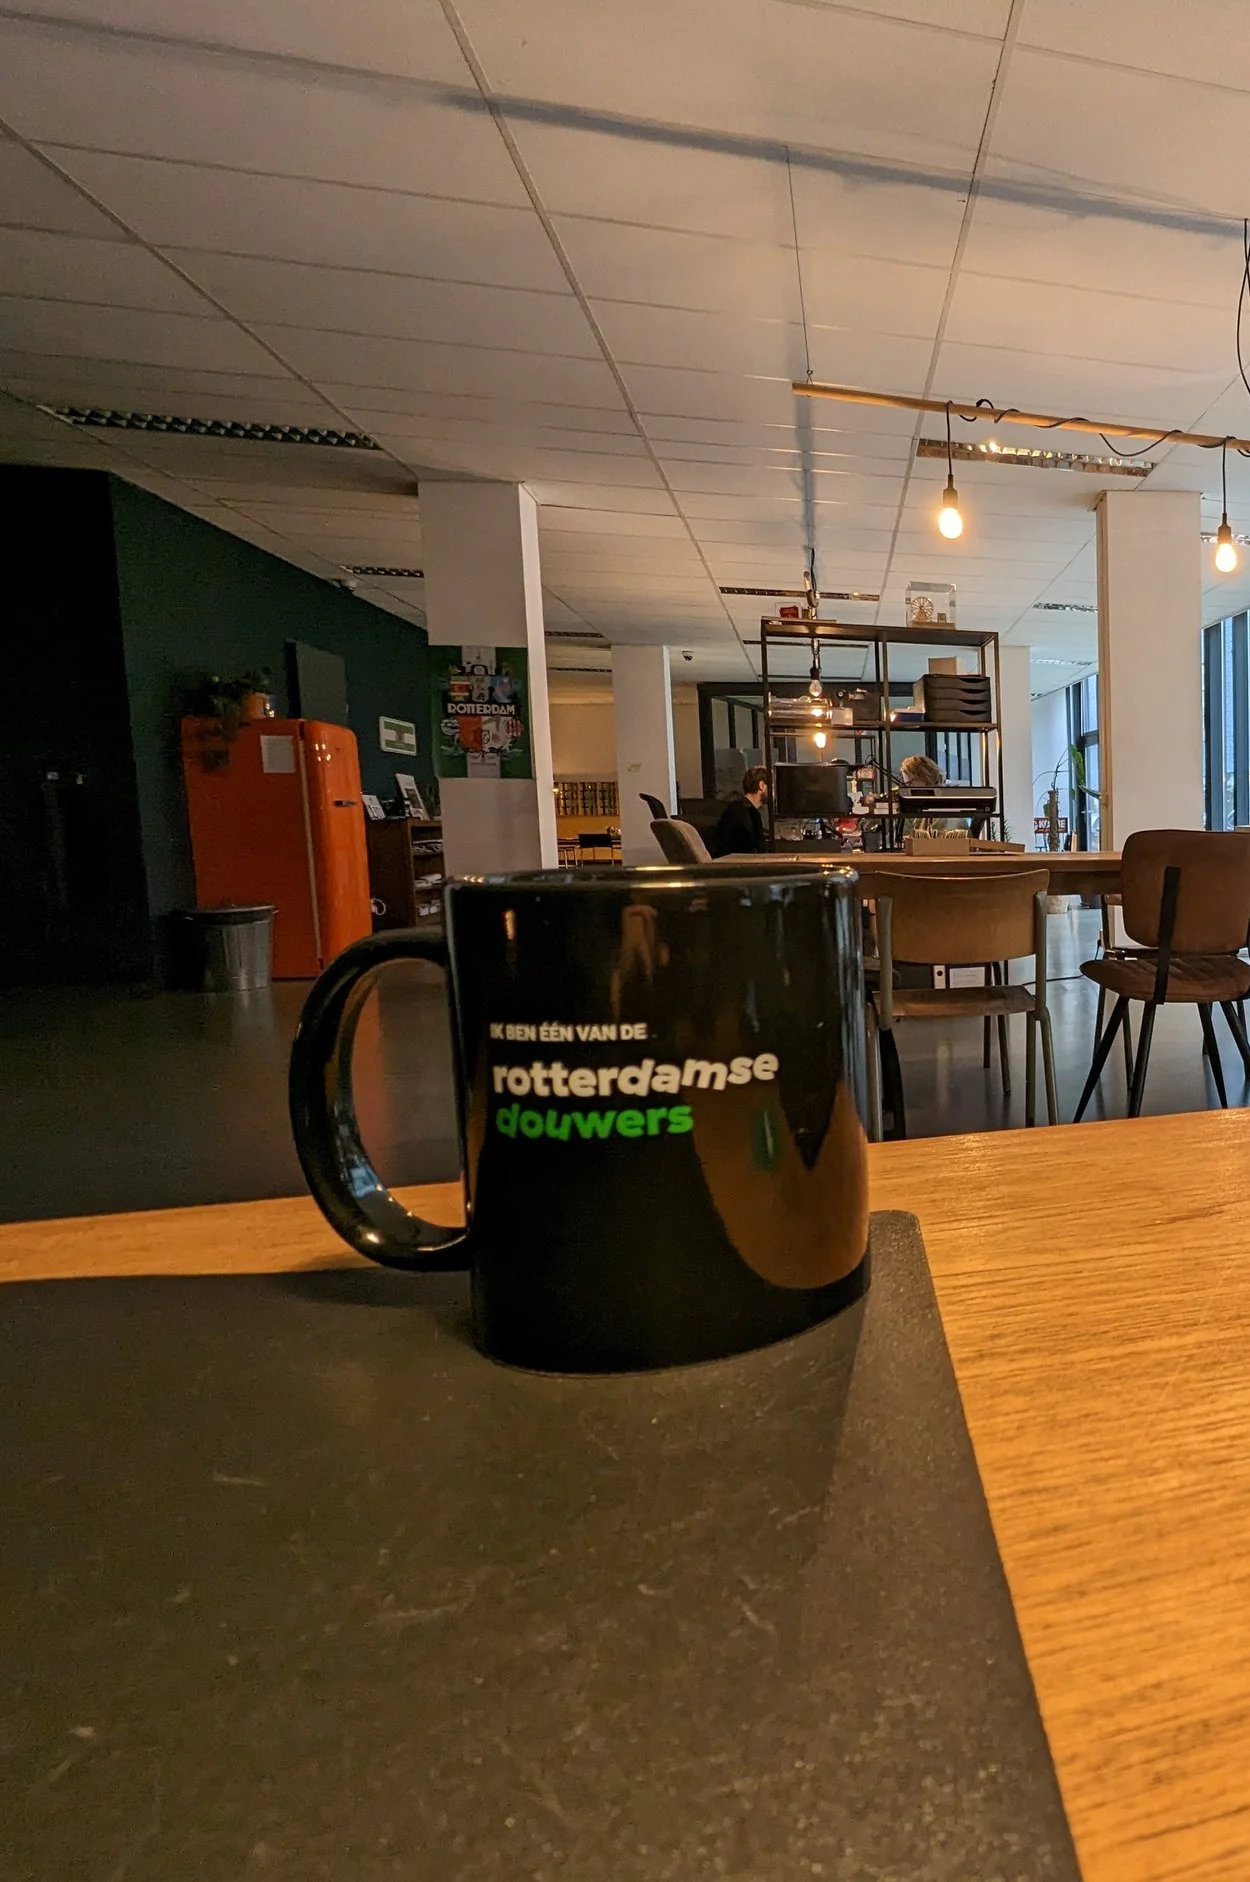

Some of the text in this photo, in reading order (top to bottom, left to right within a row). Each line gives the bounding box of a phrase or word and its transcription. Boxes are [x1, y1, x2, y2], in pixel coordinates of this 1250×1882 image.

[447, 703, 516, 715] ROTTERDAM
[490, 1020, 648, 1042] IK BEN ÉÉN VAN DE
[493, 1053, 779, 1097] rotterdamse
[496, 1103, 693, 1141] douwers
